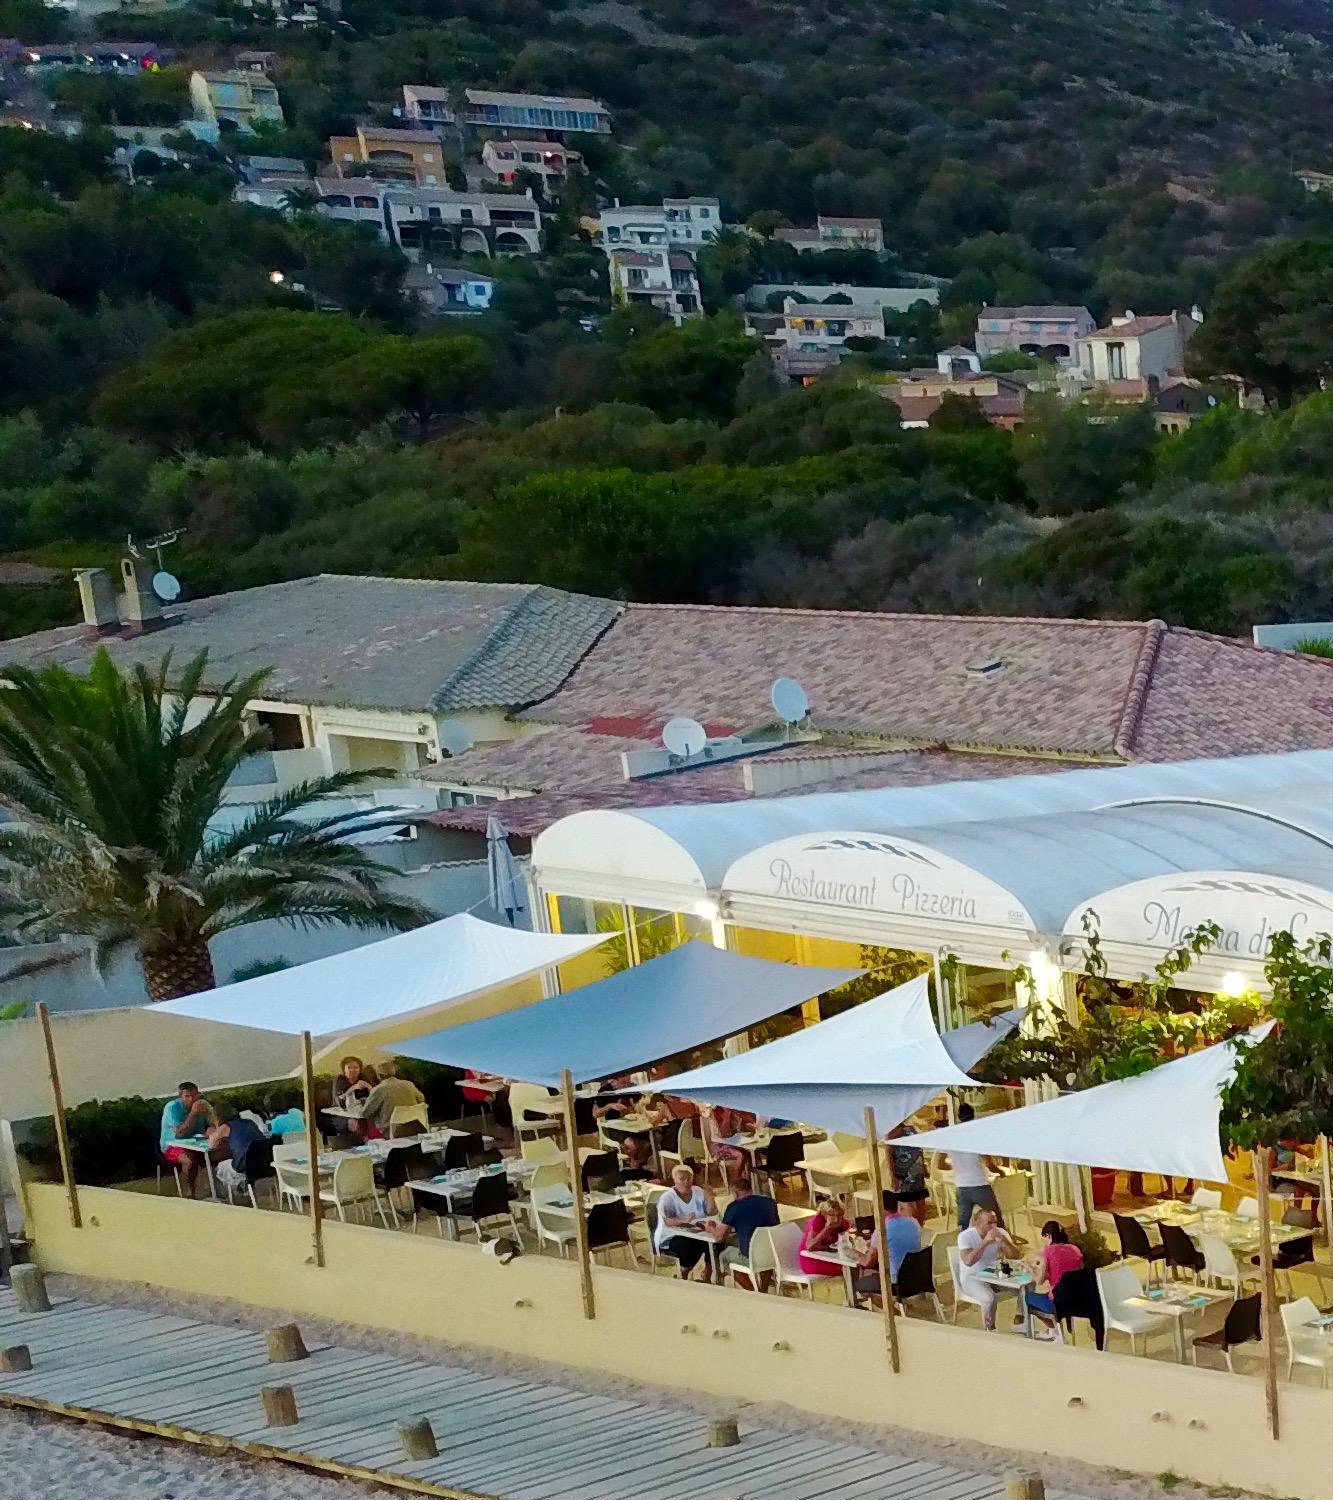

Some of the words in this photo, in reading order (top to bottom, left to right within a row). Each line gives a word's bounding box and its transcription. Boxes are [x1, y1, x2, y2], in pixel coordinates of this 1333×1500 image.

[769, 858, 877, 905] Restaurant
[892, 873, 976, 919] Pizzeria
[1144, 902, 1240, 952] Mana
